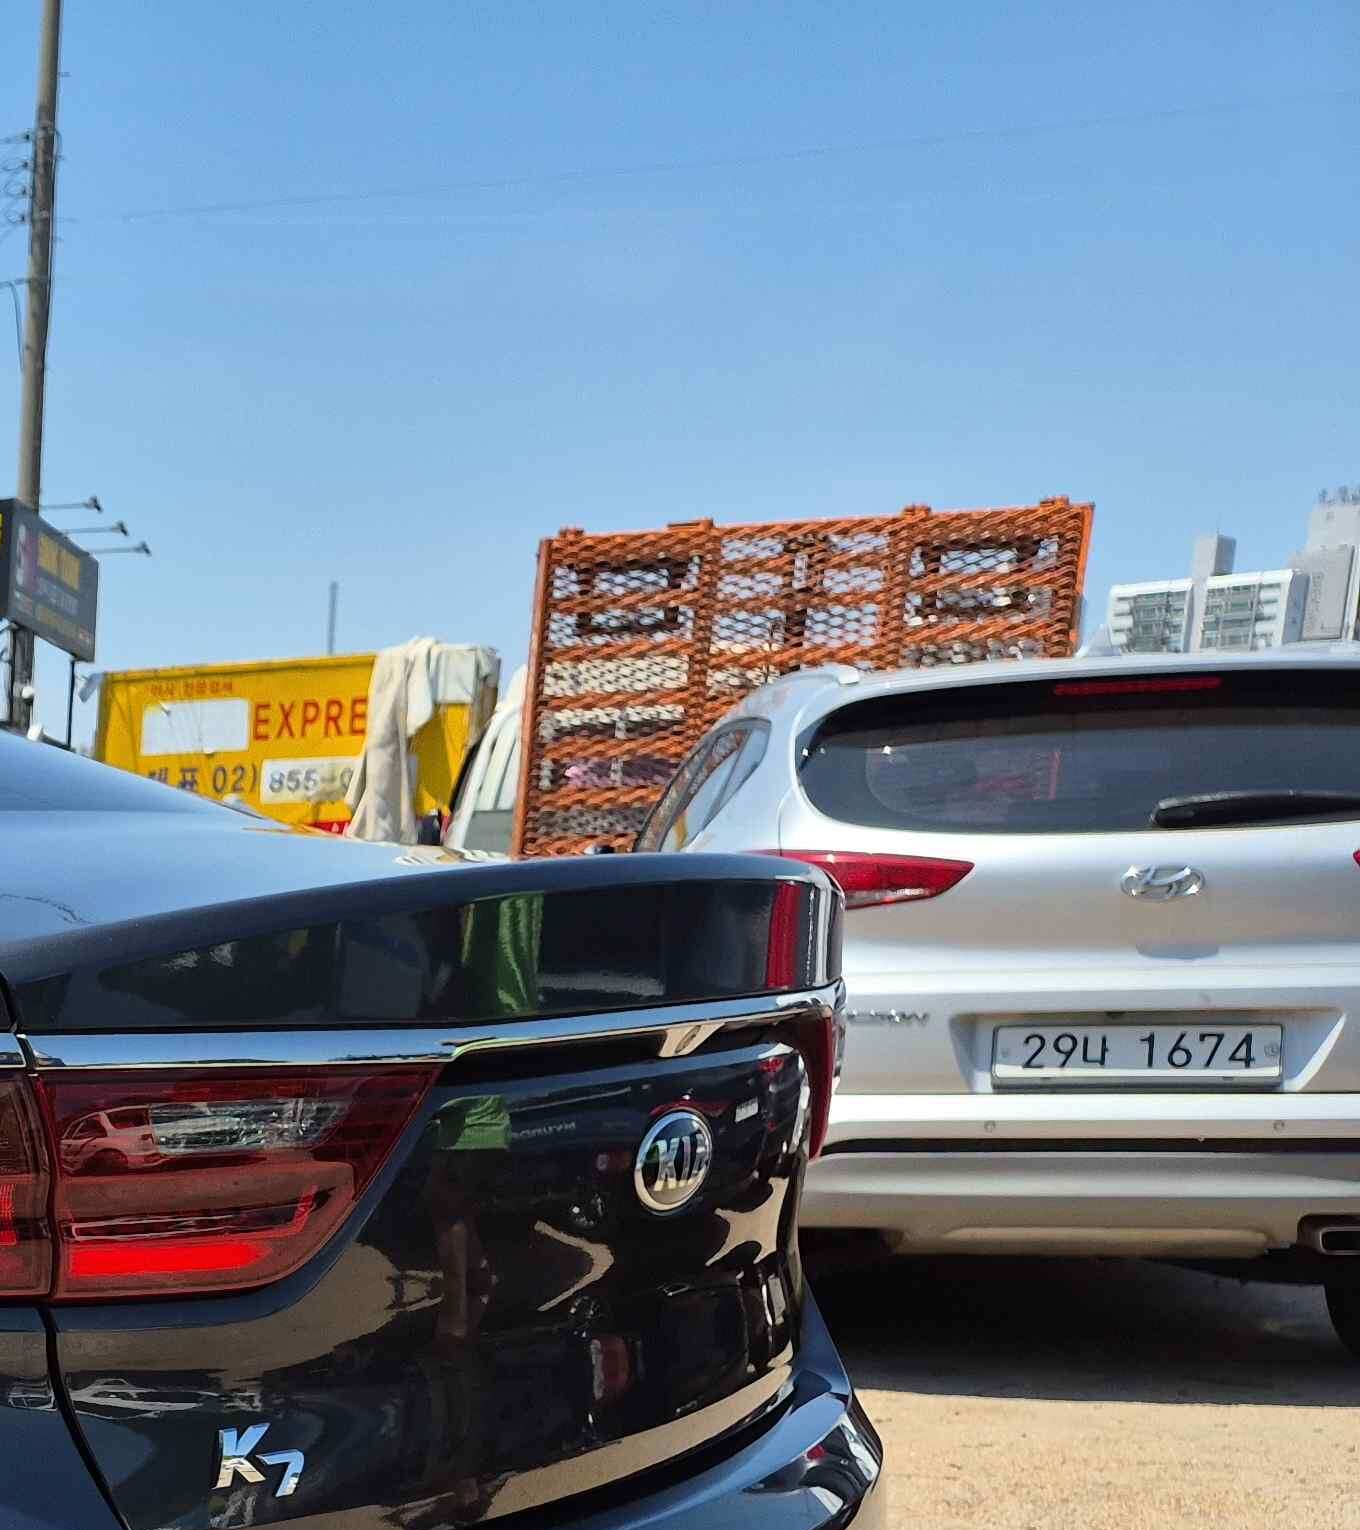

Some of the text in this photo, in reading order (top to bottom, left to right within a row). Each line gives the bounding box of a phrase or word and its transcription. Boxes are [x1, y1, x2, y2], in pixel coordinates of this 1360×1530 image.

[1021, 1032, 1256, 1069] 29나 1674
[211, 1422, 305, 1498] K7
